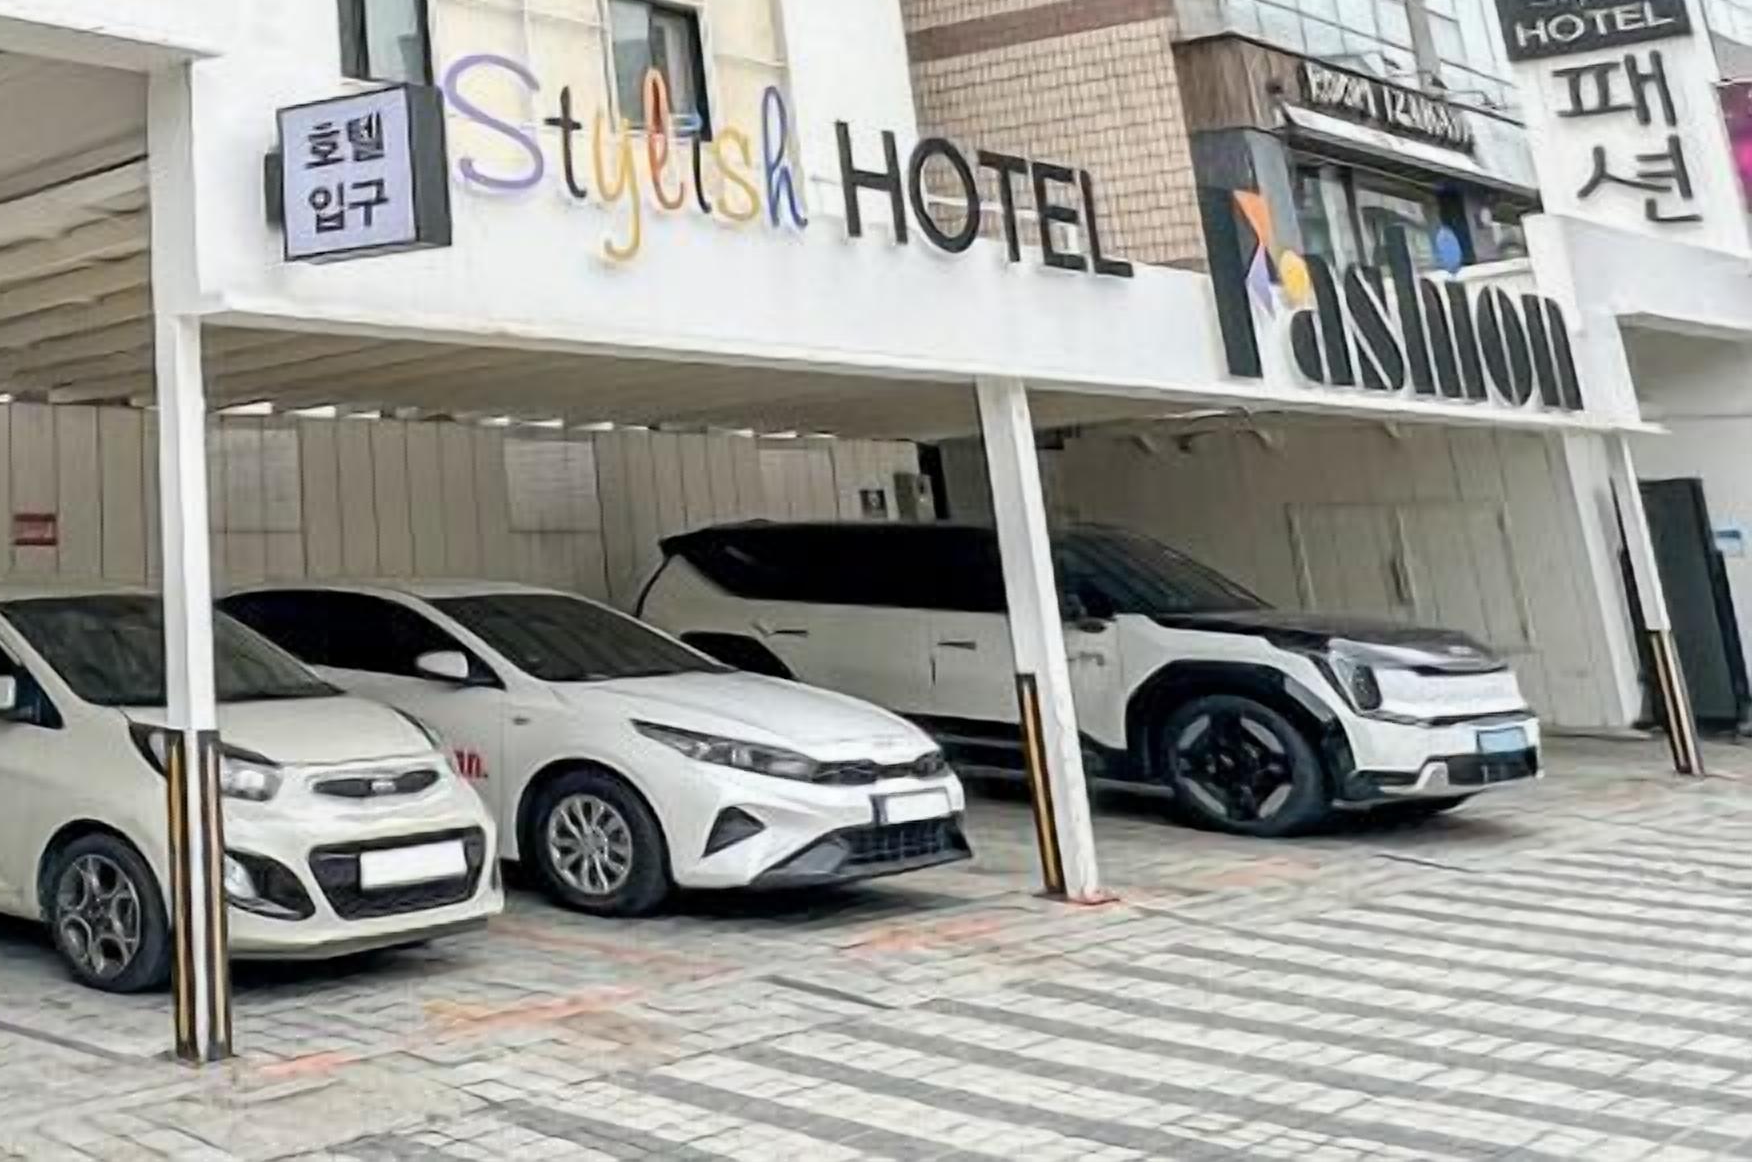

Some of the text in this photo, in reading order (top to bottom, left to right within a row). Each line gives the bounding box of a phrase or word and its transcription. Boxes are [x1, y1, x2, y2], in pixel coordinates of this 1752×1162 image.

[1514, 0, 1676, 49] HOTEL
[305, 111, 385, 169] 호텔
[441, 53, 1134, 278] Stylish HOTEL
[308, 178, 389, 234] 입구
